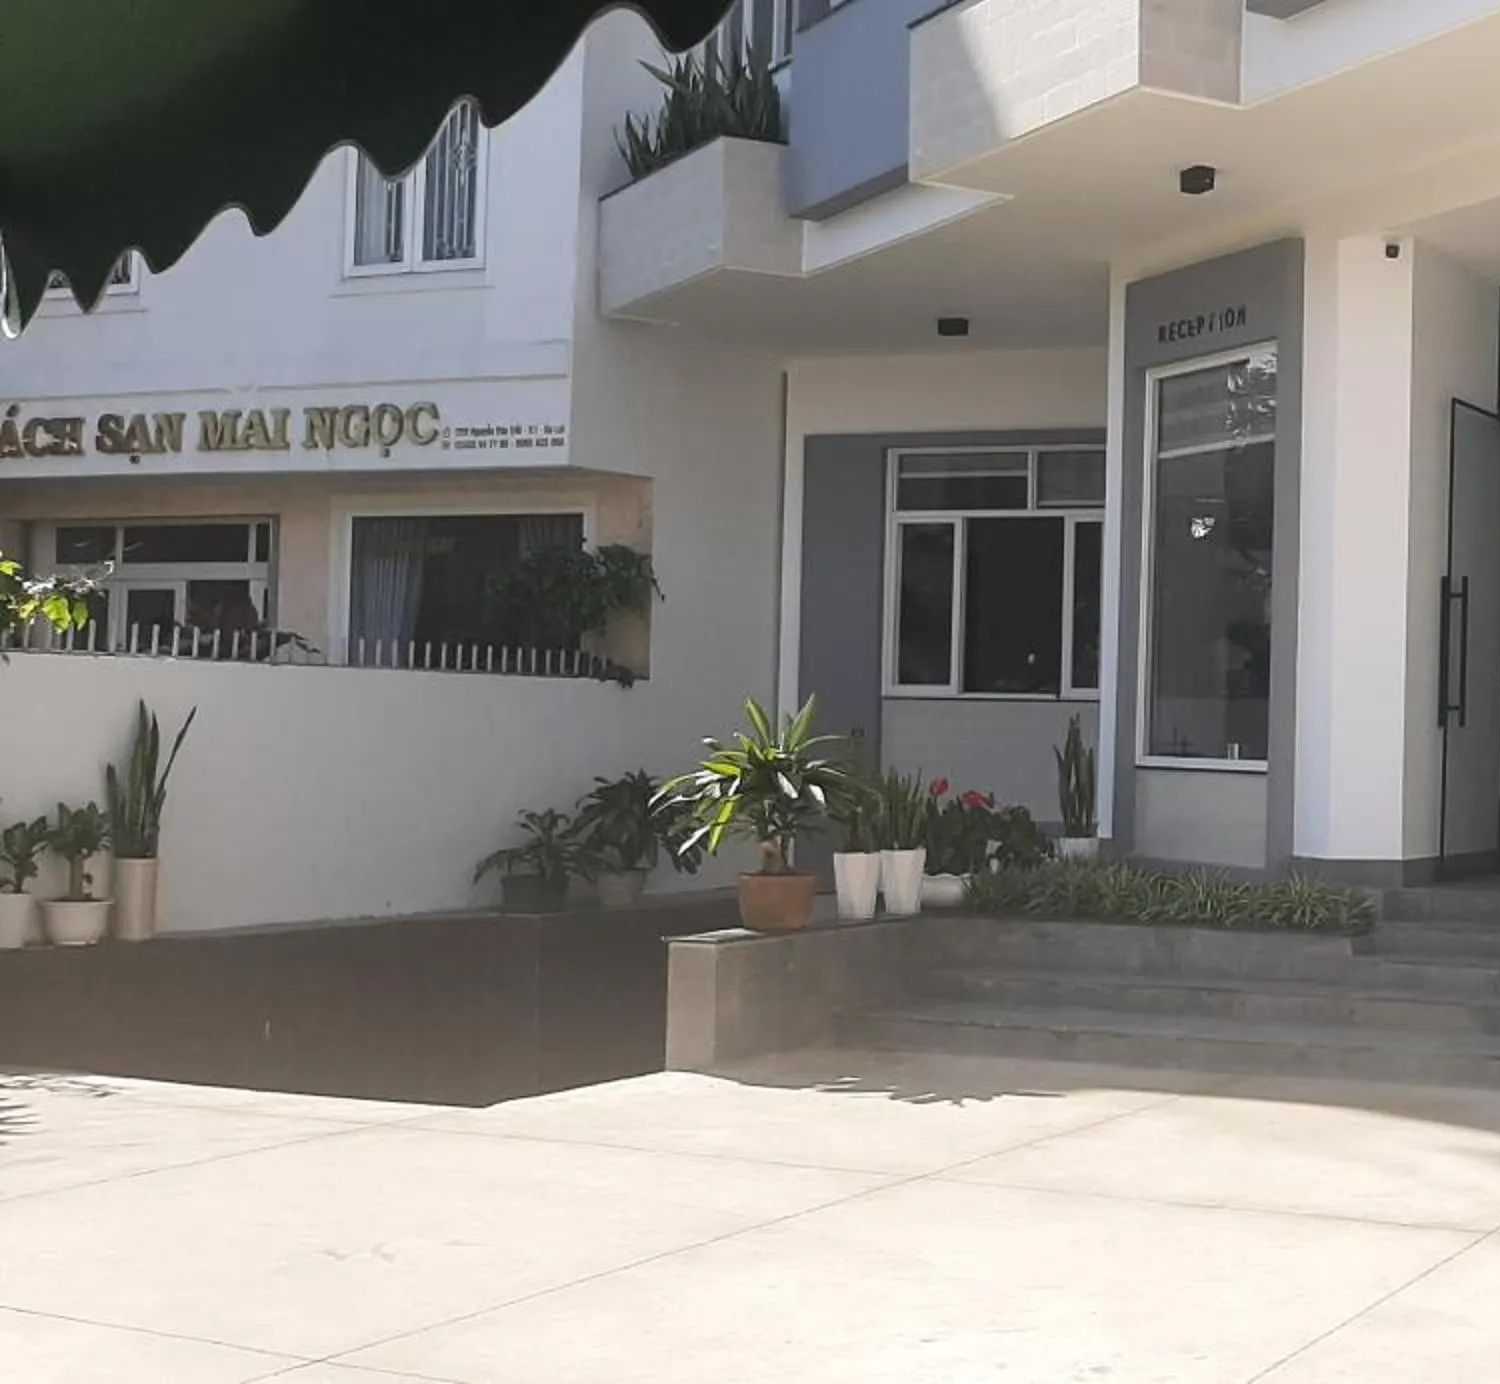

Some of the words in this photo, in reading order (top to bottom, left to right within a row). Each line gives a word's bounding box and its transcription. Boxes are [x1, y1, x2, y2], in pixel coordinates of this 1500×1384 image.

[1157, 304, 1247, 343] RECEPTION
[95, 412, 187, 464] SẠN
[197, 408, 291, 452] MAI
[302, 401, 440, 458] NGỌC
